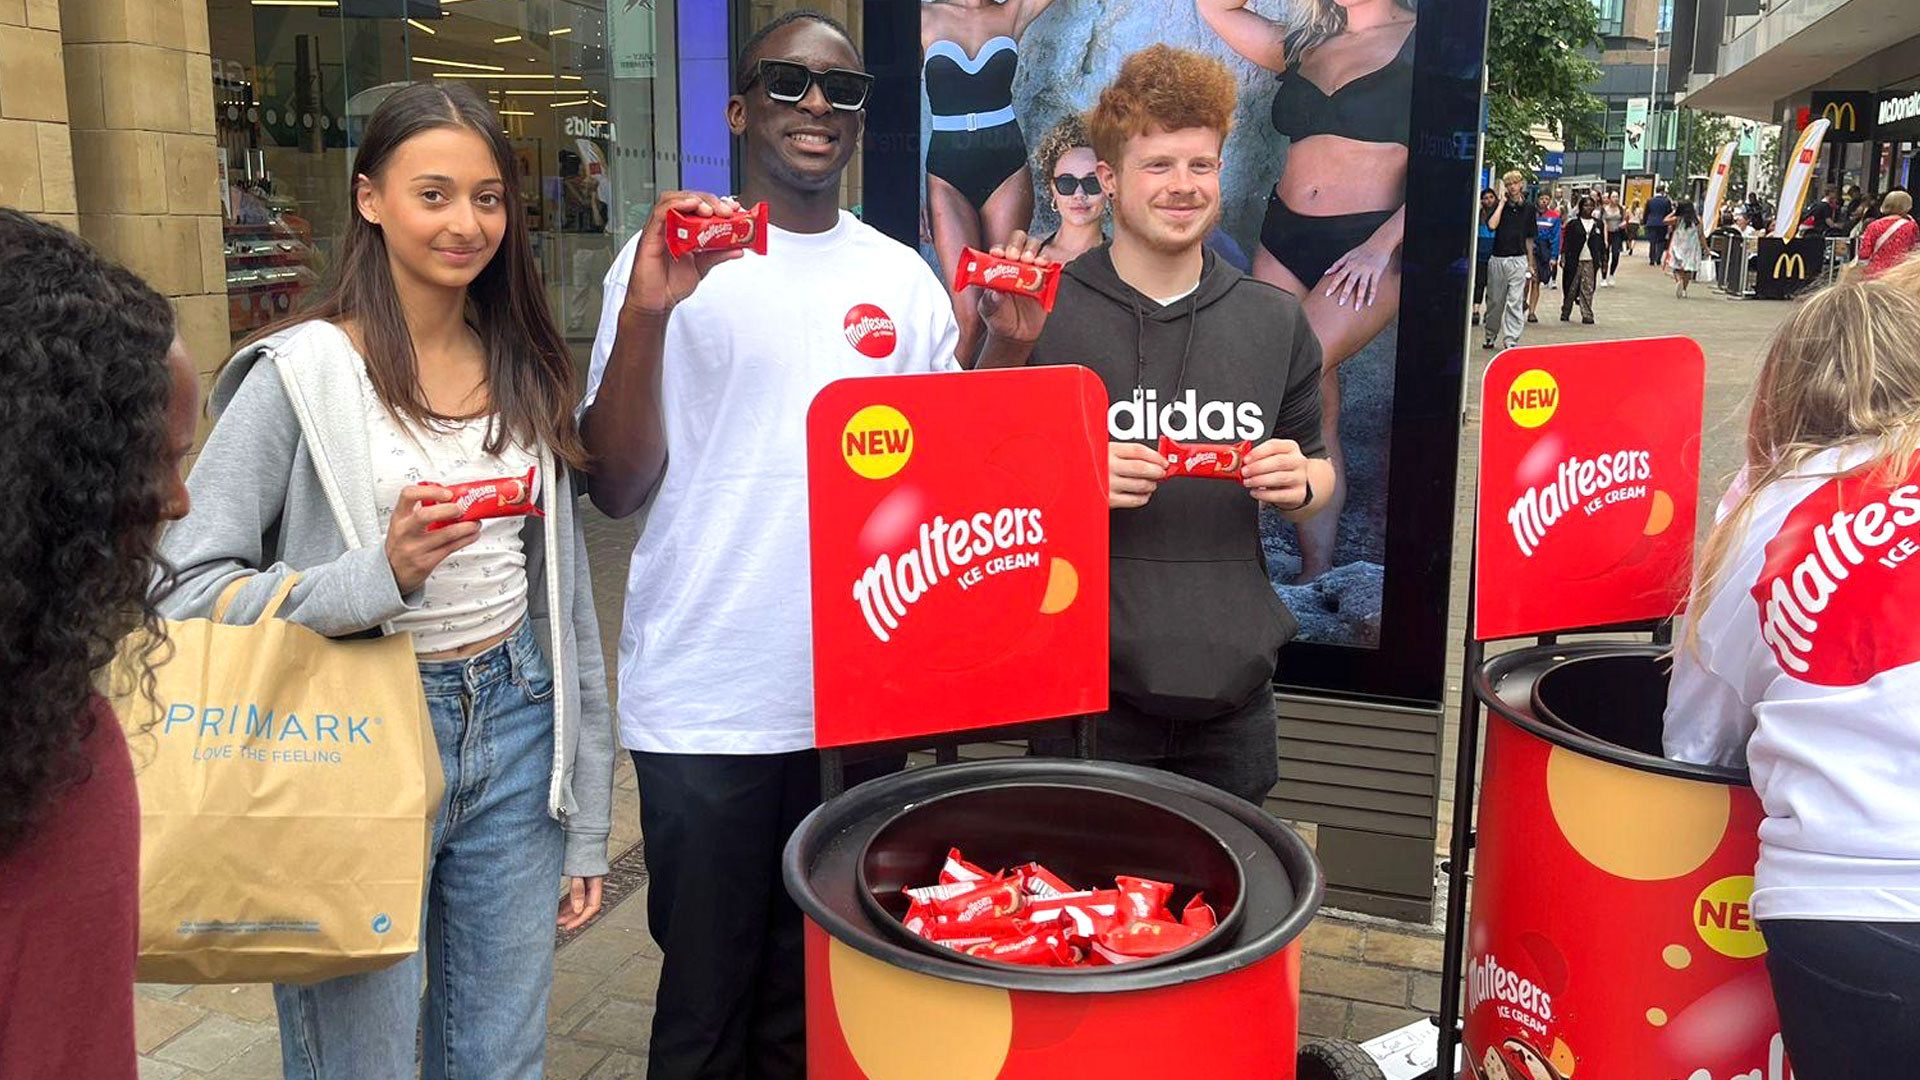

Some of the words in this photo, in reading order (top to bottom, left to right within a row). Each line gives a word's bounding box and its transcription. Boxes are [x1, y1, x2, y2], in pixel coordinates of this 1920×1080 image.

[844, 315, 894, 347] Maltesers
[1107, 388, 1265, 441] didas
[1510, 388, 1557, 410] NEW
[846, 428, 910, 457] NEW
[1508, 450, 1651, 557] Maltesers
[1584, 497, 1603, 517] ICE
[1604, 485, 1646, 505] CREAM
[1878, 537, 1920, 569] ICE
[853, 508, 1044, 643] Maltesers
[957, 566, 984, 591] ICE
[985, 552, 1040, 576] CREAM
[164, 703, 372, 745] PRIMARK
[193, 745, 232, 761] LOVE
[240, 745, 266, 762] THE
[272, 750, 342, 763] FEELING
[1699, 898, 1763, 932] NE
[1469, 953, 1552, 1020] Maltesers
[1511, 1008, 1547, 1036] CREAM
